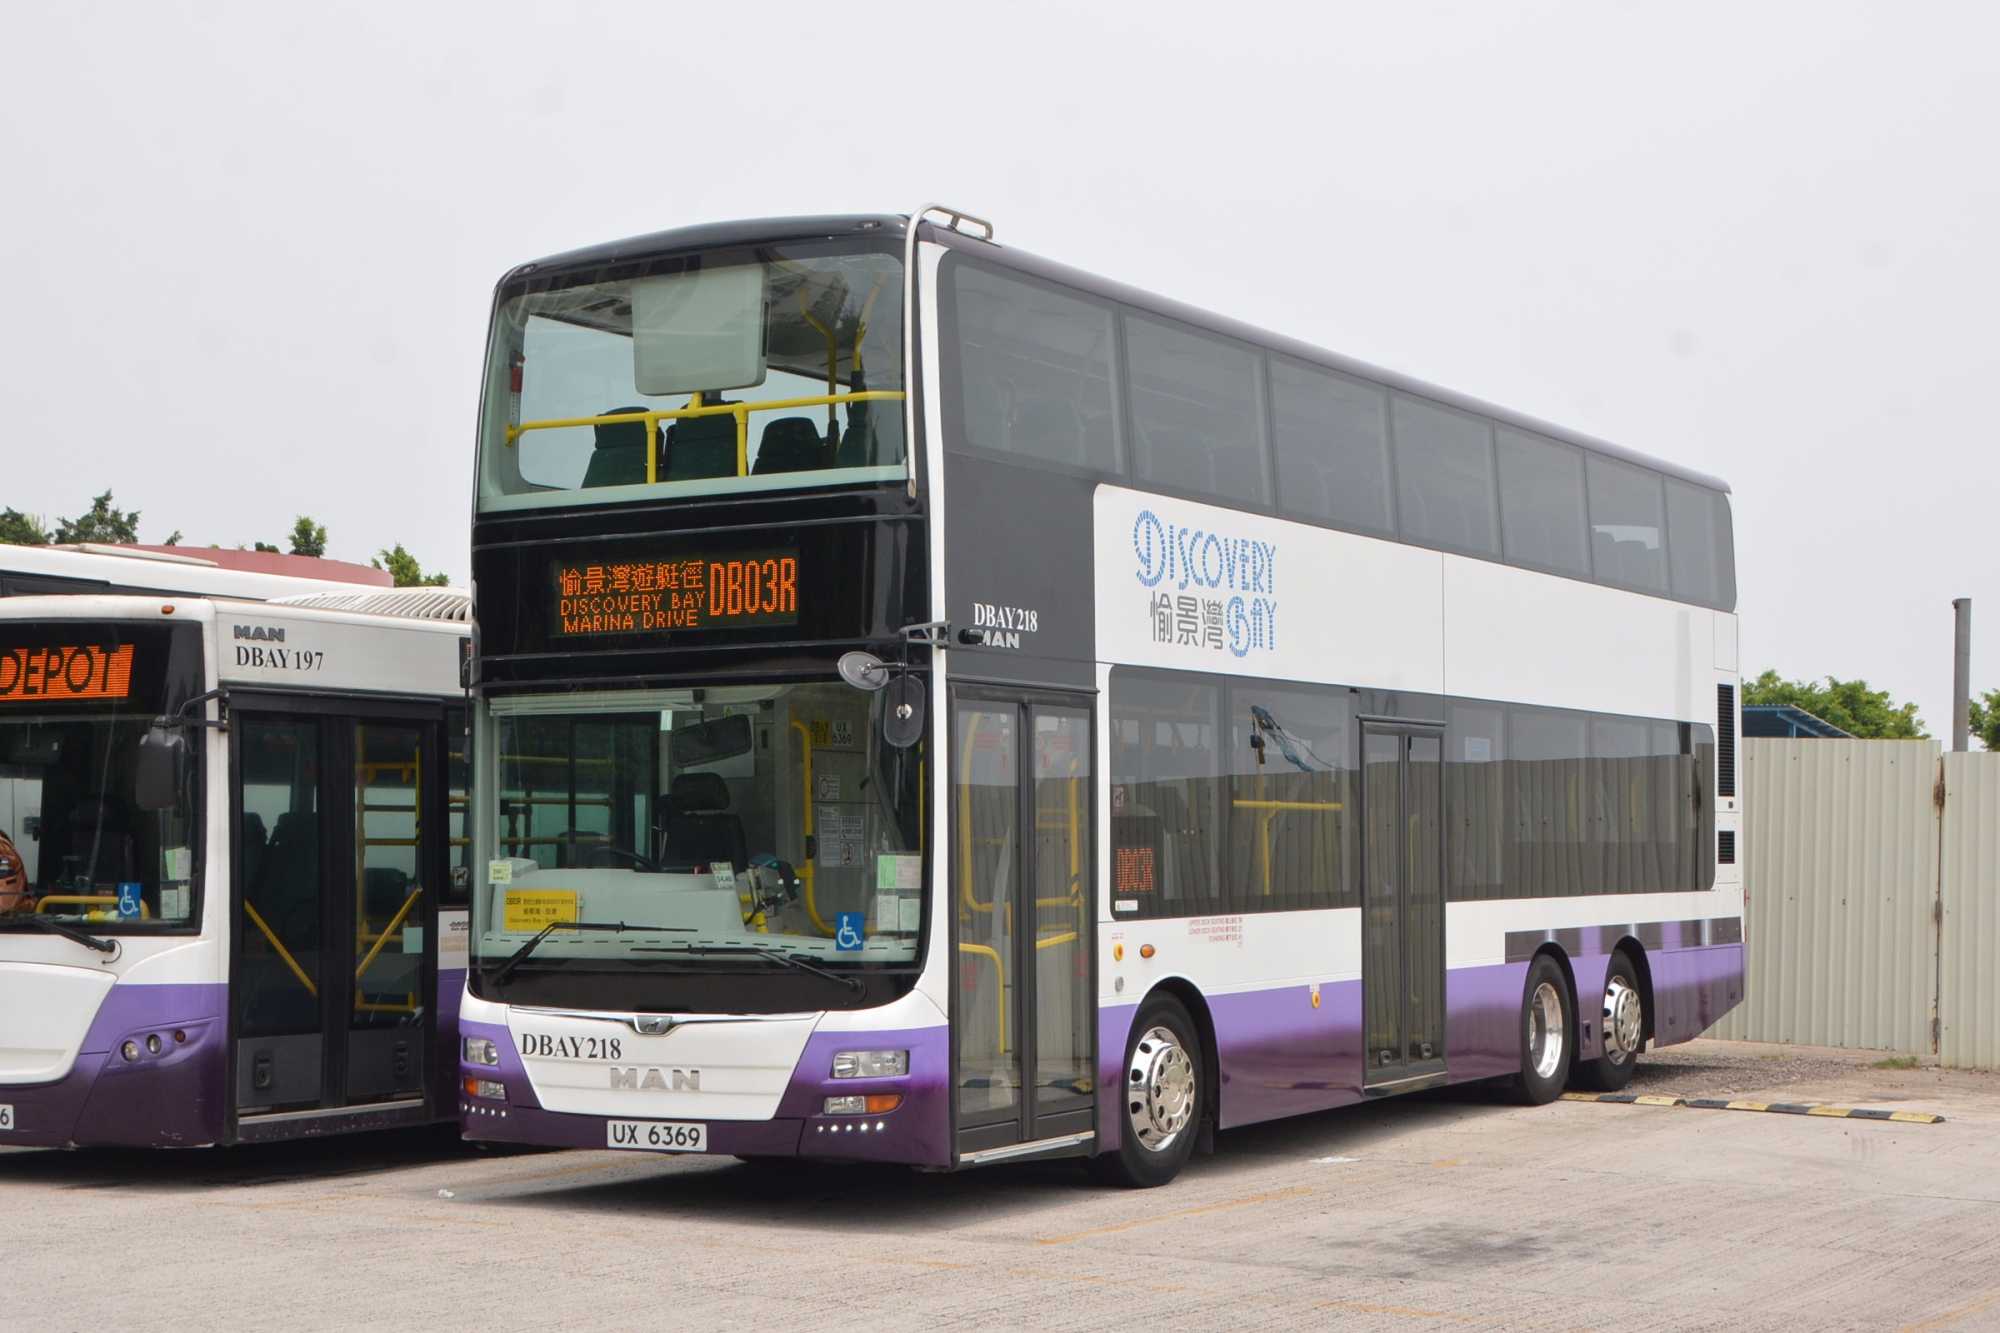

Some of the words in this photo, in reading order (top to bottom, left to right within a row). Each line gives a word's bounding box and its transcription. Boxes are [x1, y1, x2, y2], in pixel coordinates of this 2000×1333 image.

[1134, 510, 1276, 594] DISCOVERY
[560, 560, 705, 596] 愉景灣遊艇徑
[710, 558, 795, 616] DB03R
[560, 594, 661, 616] DISCOVERY
[671, 591, 705, 609] BAY
[564, 613, 634, 633] MARINA
[643, 609, 699, 629] DRIVE
[1150, 591, 1224, 650] 愉景灣
[234, 624, 286, 643] MAN
[1227, 596, 1277, 658] BAY
[0, 644, 120, 696] DEPOT
[610, 1067, 701, 1091] MAN
[612, 1124, 639, 1145] UX
[648, 1125, 701, 1147] 6369
